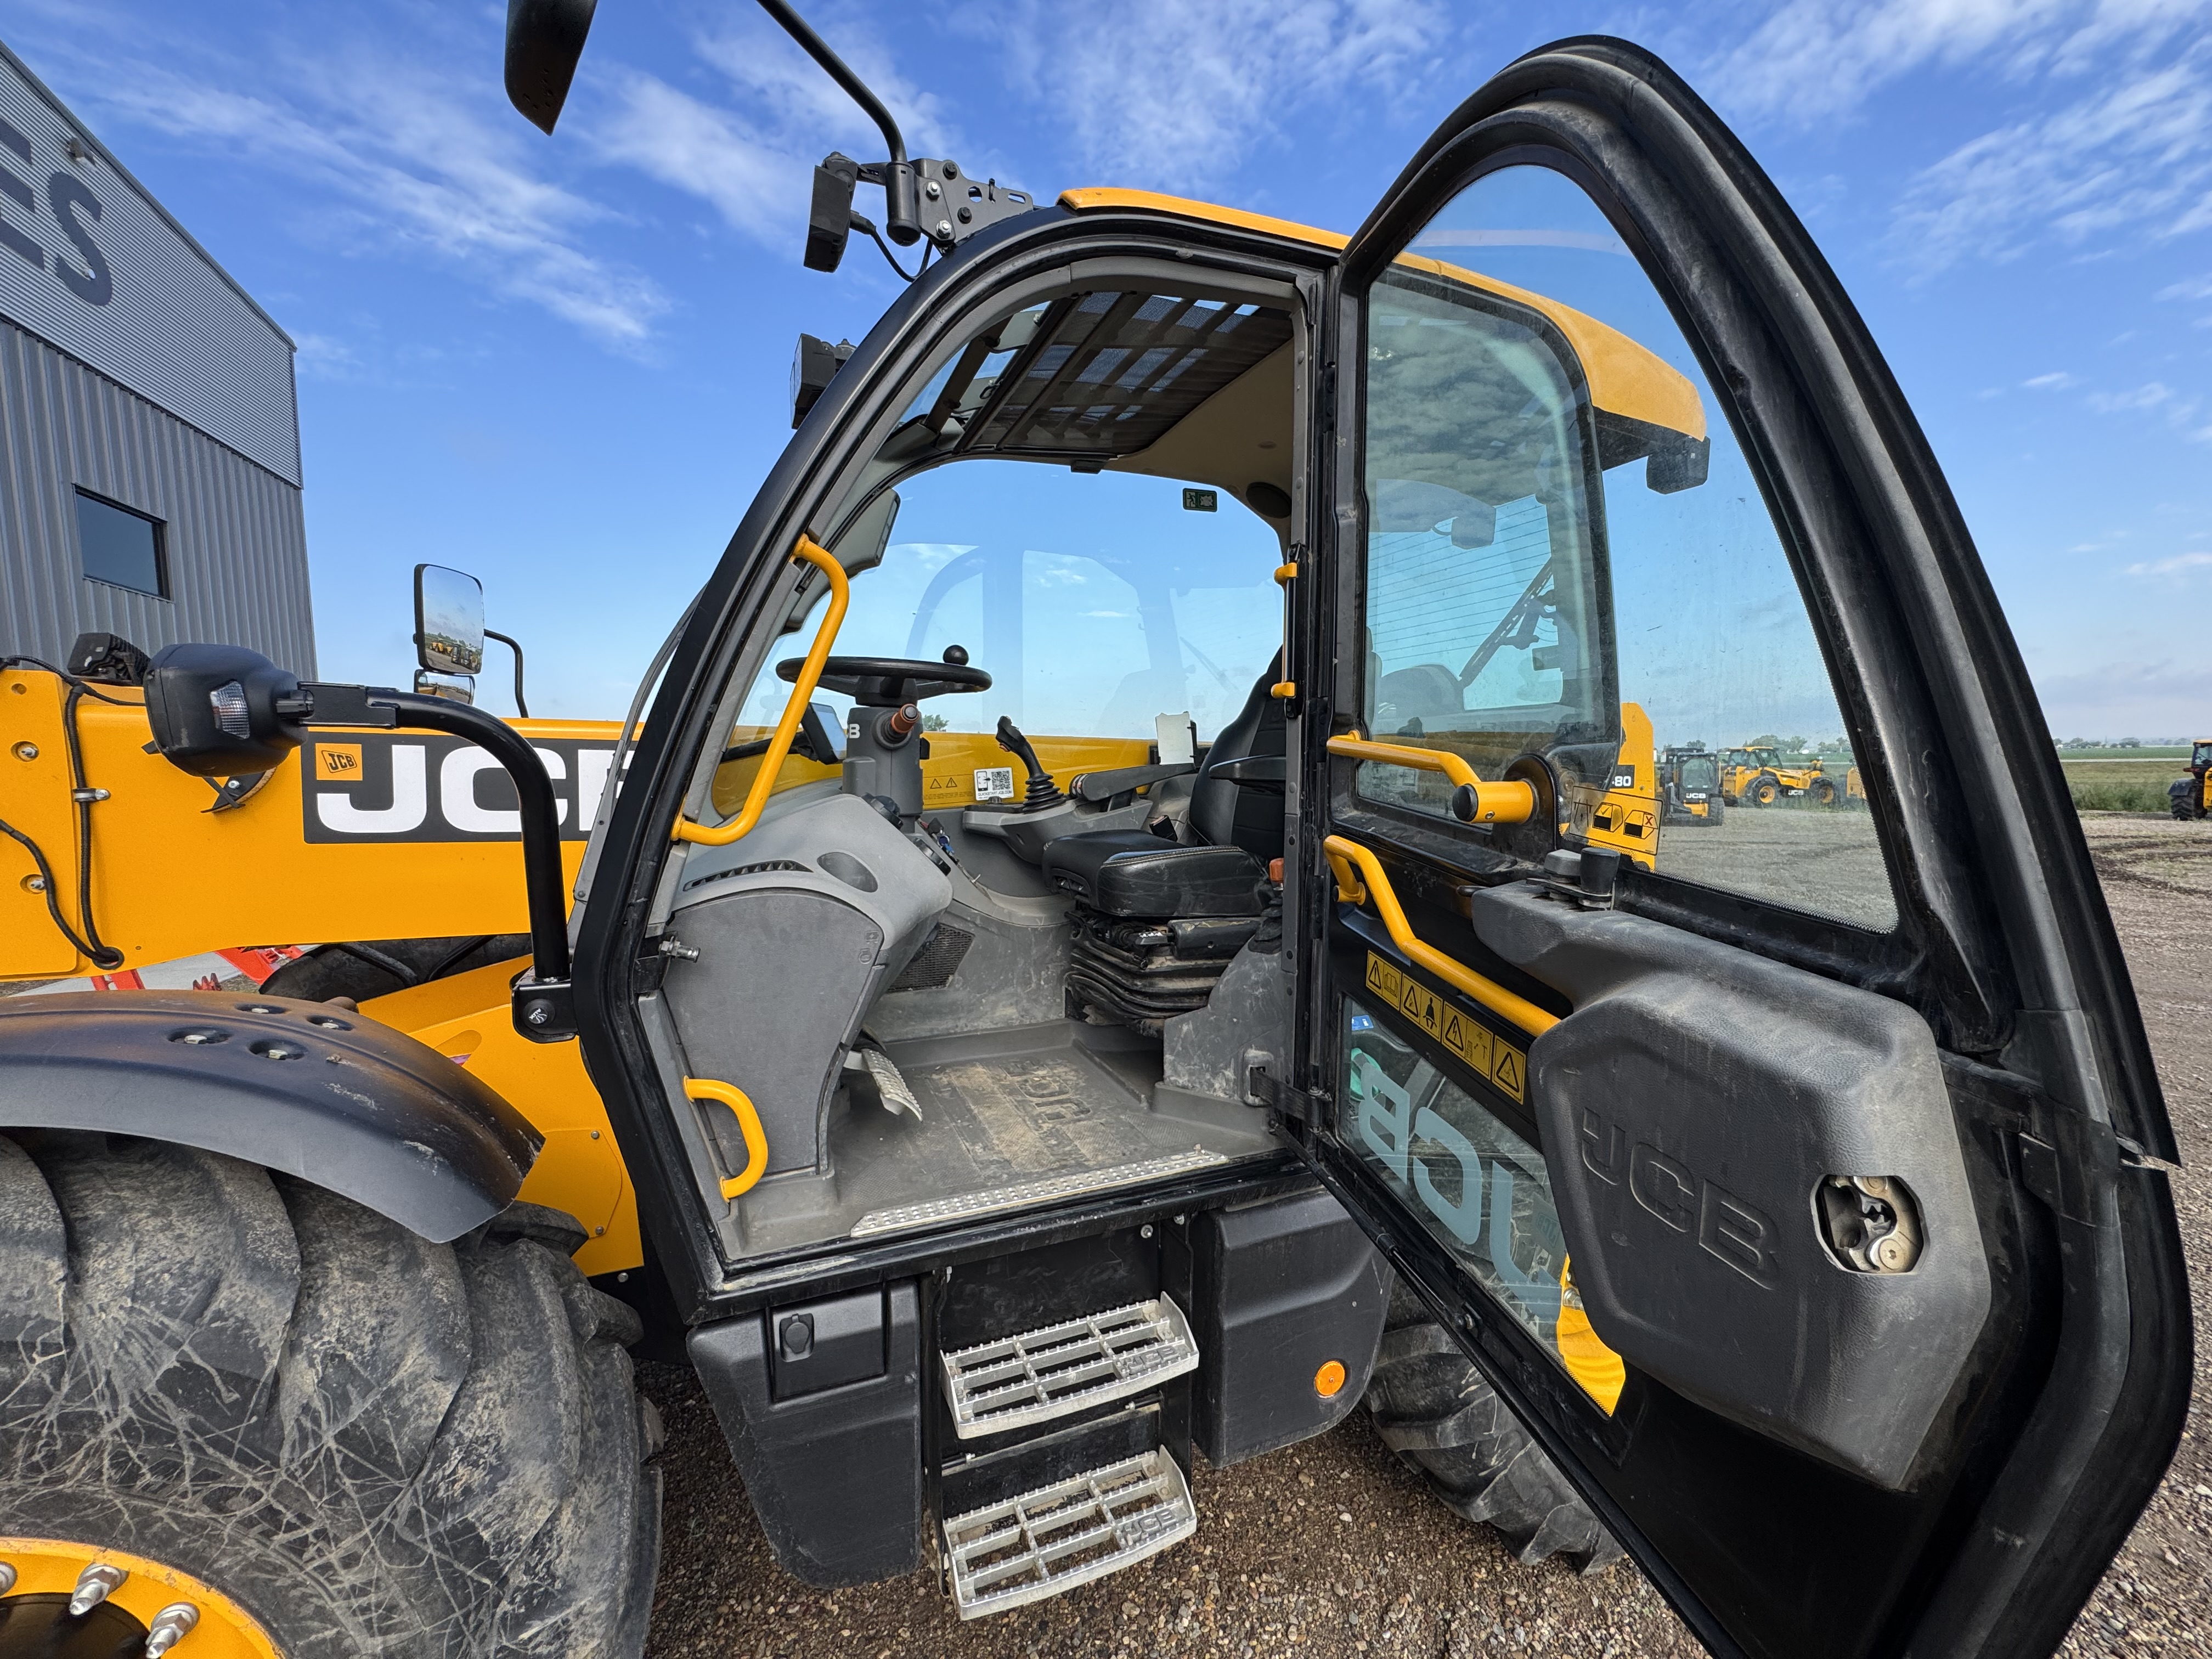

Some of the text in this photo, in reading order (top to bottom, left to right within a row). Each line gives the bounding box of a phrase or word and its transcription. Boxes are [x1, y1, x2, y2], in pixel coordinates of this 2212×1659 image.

[328, 753, 354, 770] JCB
[1582, 1107, 1779, 1290] JCB
[1126, 1346, 1180, 1375] JCB
[1124, 1509, 1178, 1543] JCB
